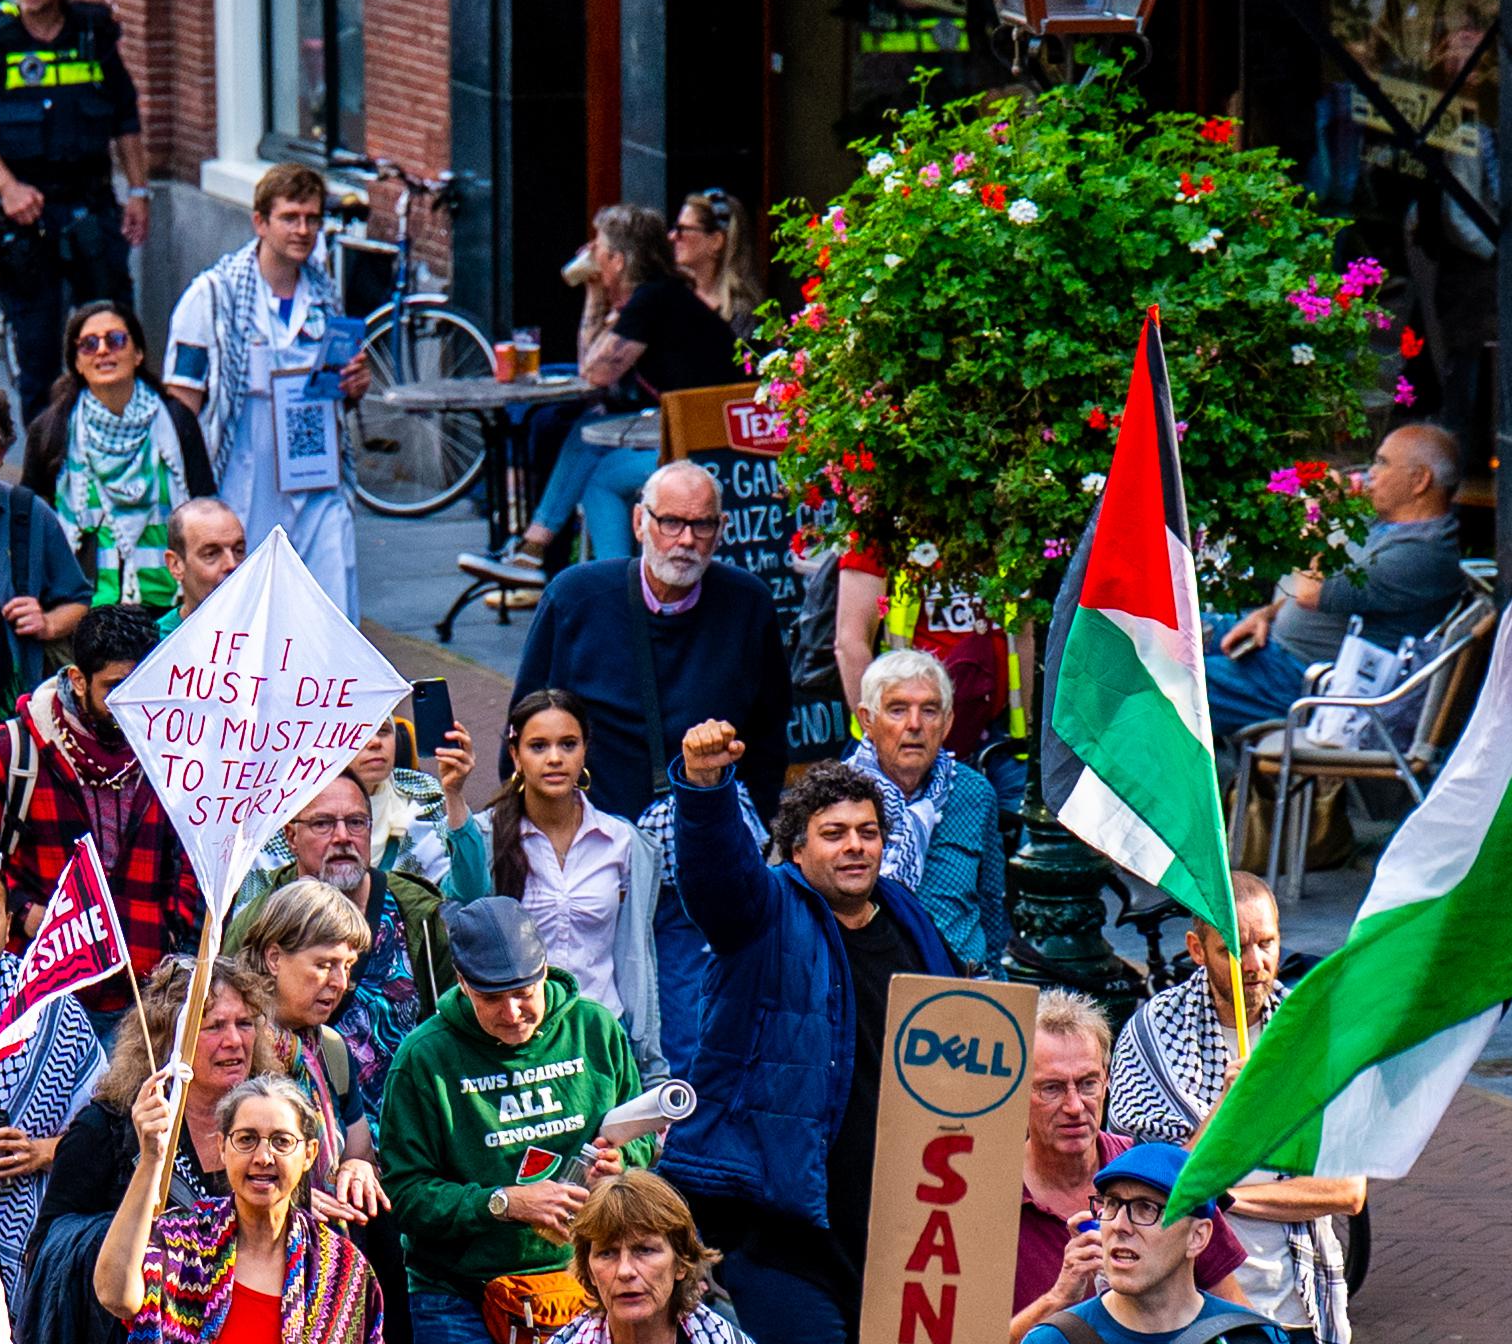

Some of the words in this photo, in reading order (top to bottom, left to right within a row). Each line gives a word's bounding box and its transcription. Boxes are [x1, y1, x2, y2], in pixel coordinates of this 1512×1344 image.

[732, 407, 778, 439] TEX
[210, 631, 251, 665] IF
[280, 637, 293, 672] I
[168, 664, 269, 708] MUST
[295, 676, 358, 709] DIE
[141, 702, 207, 748] YOU
[220, 716, 313, 752] MUST
[313, 718, 372, 752] LIVE
[161, 754, 206, 793] TO
[220, 759, 281, 792] TELL
[289, 757, 333, 790] MY
[904, 1026, 1014, 1080] DELL
[461, 1074, 511, 1098] JEWS
[513, 1058, 586, 1092] AGAINST
[499, 1089, 563, 1124] ALL
[484, 1111, 586, 1150] GENOCIDES
